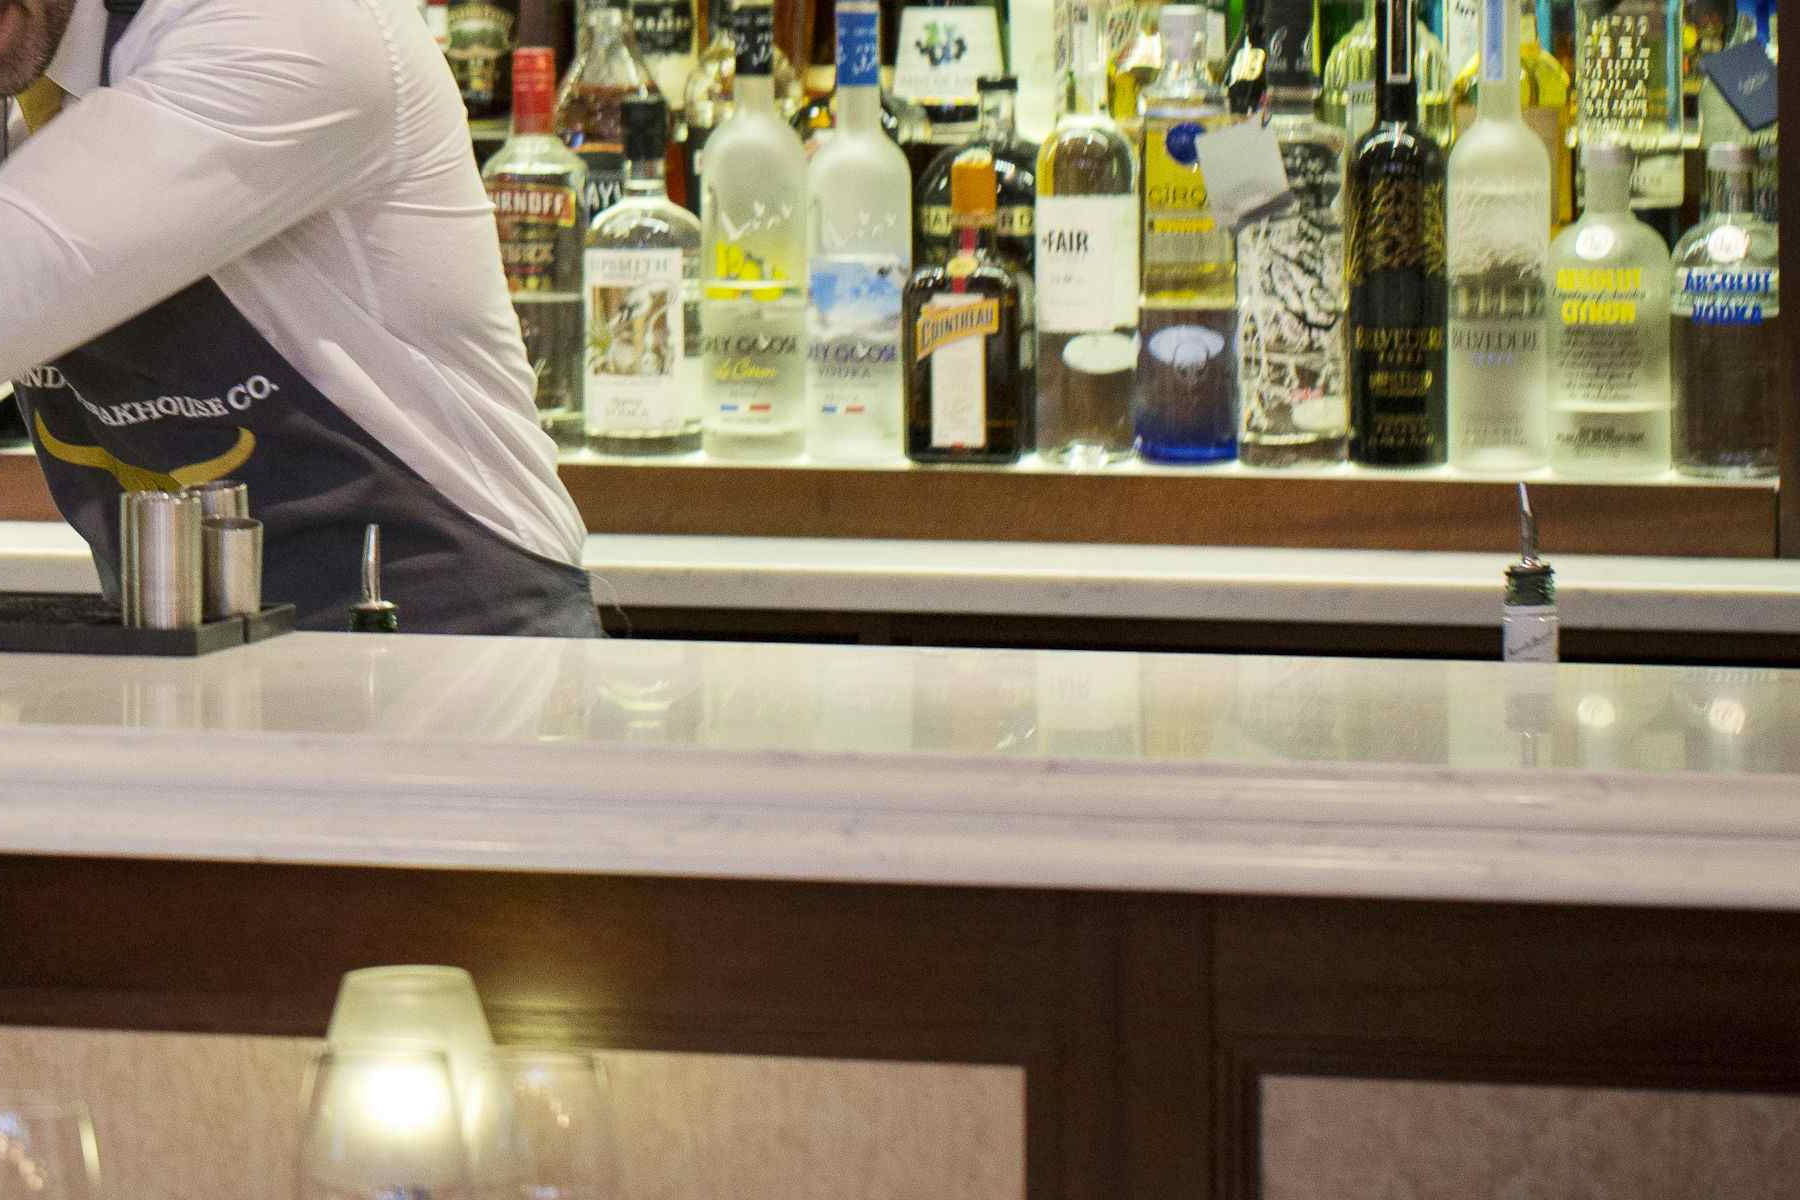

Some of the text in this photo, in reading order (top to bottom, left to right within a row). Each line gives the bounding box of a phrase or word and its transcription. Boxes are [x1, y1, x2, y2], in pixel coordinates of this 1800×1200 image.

[491, 189, 563, 216] IRNOFF
[1047, 228, 1090, 253] FAIR
[1556, 268, 1642, 291] ABSOLUT
[1685, 271, 1773, 295] ABSOLUT
[921, 303, 995, 346] COINTREAU
[1691, 303, 1764, 327] VODKA
[227, 375, 280, 411] CO.
